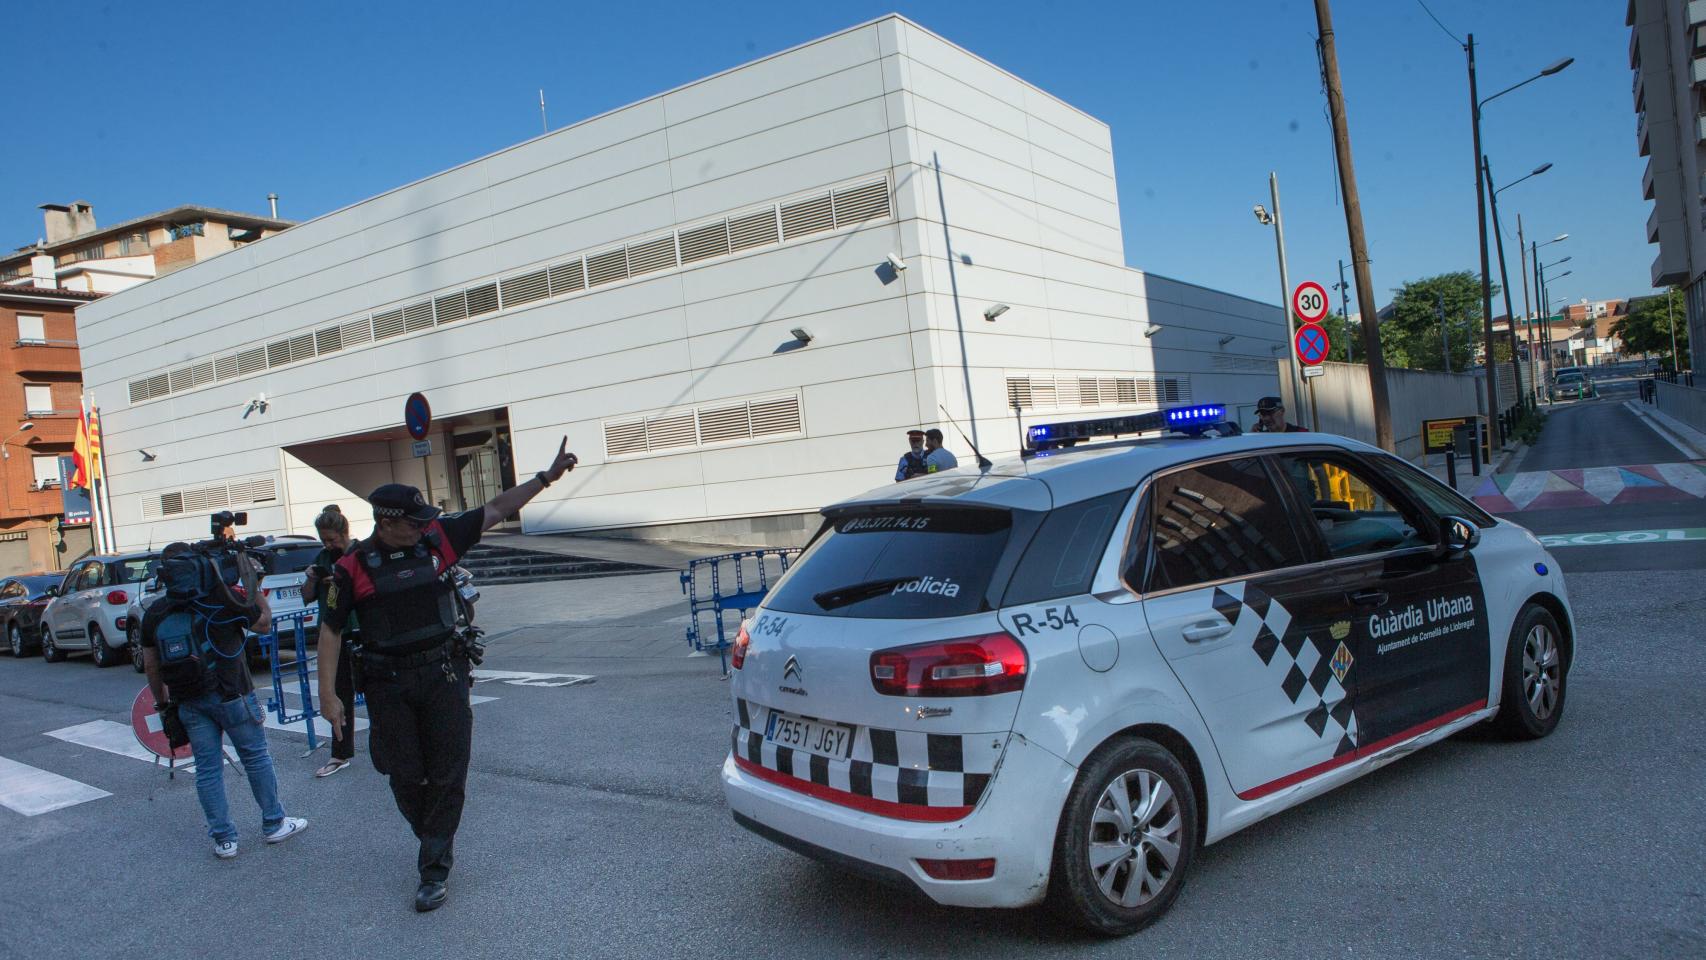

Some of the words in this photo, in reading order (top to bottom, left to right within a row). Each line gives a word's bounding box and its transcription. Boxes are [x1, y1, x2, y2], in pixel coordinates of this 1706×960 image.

[1301, 294, 1321, 310] 30
[754, 617, 788, 637] R-54
[1011, 605, 1080, 636] R-54
[1369, 604, 1423, 639] Guàrdia
[1427, 595, 1473, 621] Urbana
[1377, 637, 1410, 655] Ajuntament
[1411, 634, 1418, 644] de
[1442, 625, 1449, 634] de
[1450, 617, 1474, 632] Llobregat
[775, 717, 810, 747] 7551
[814, 727, 846, 756] JGY
